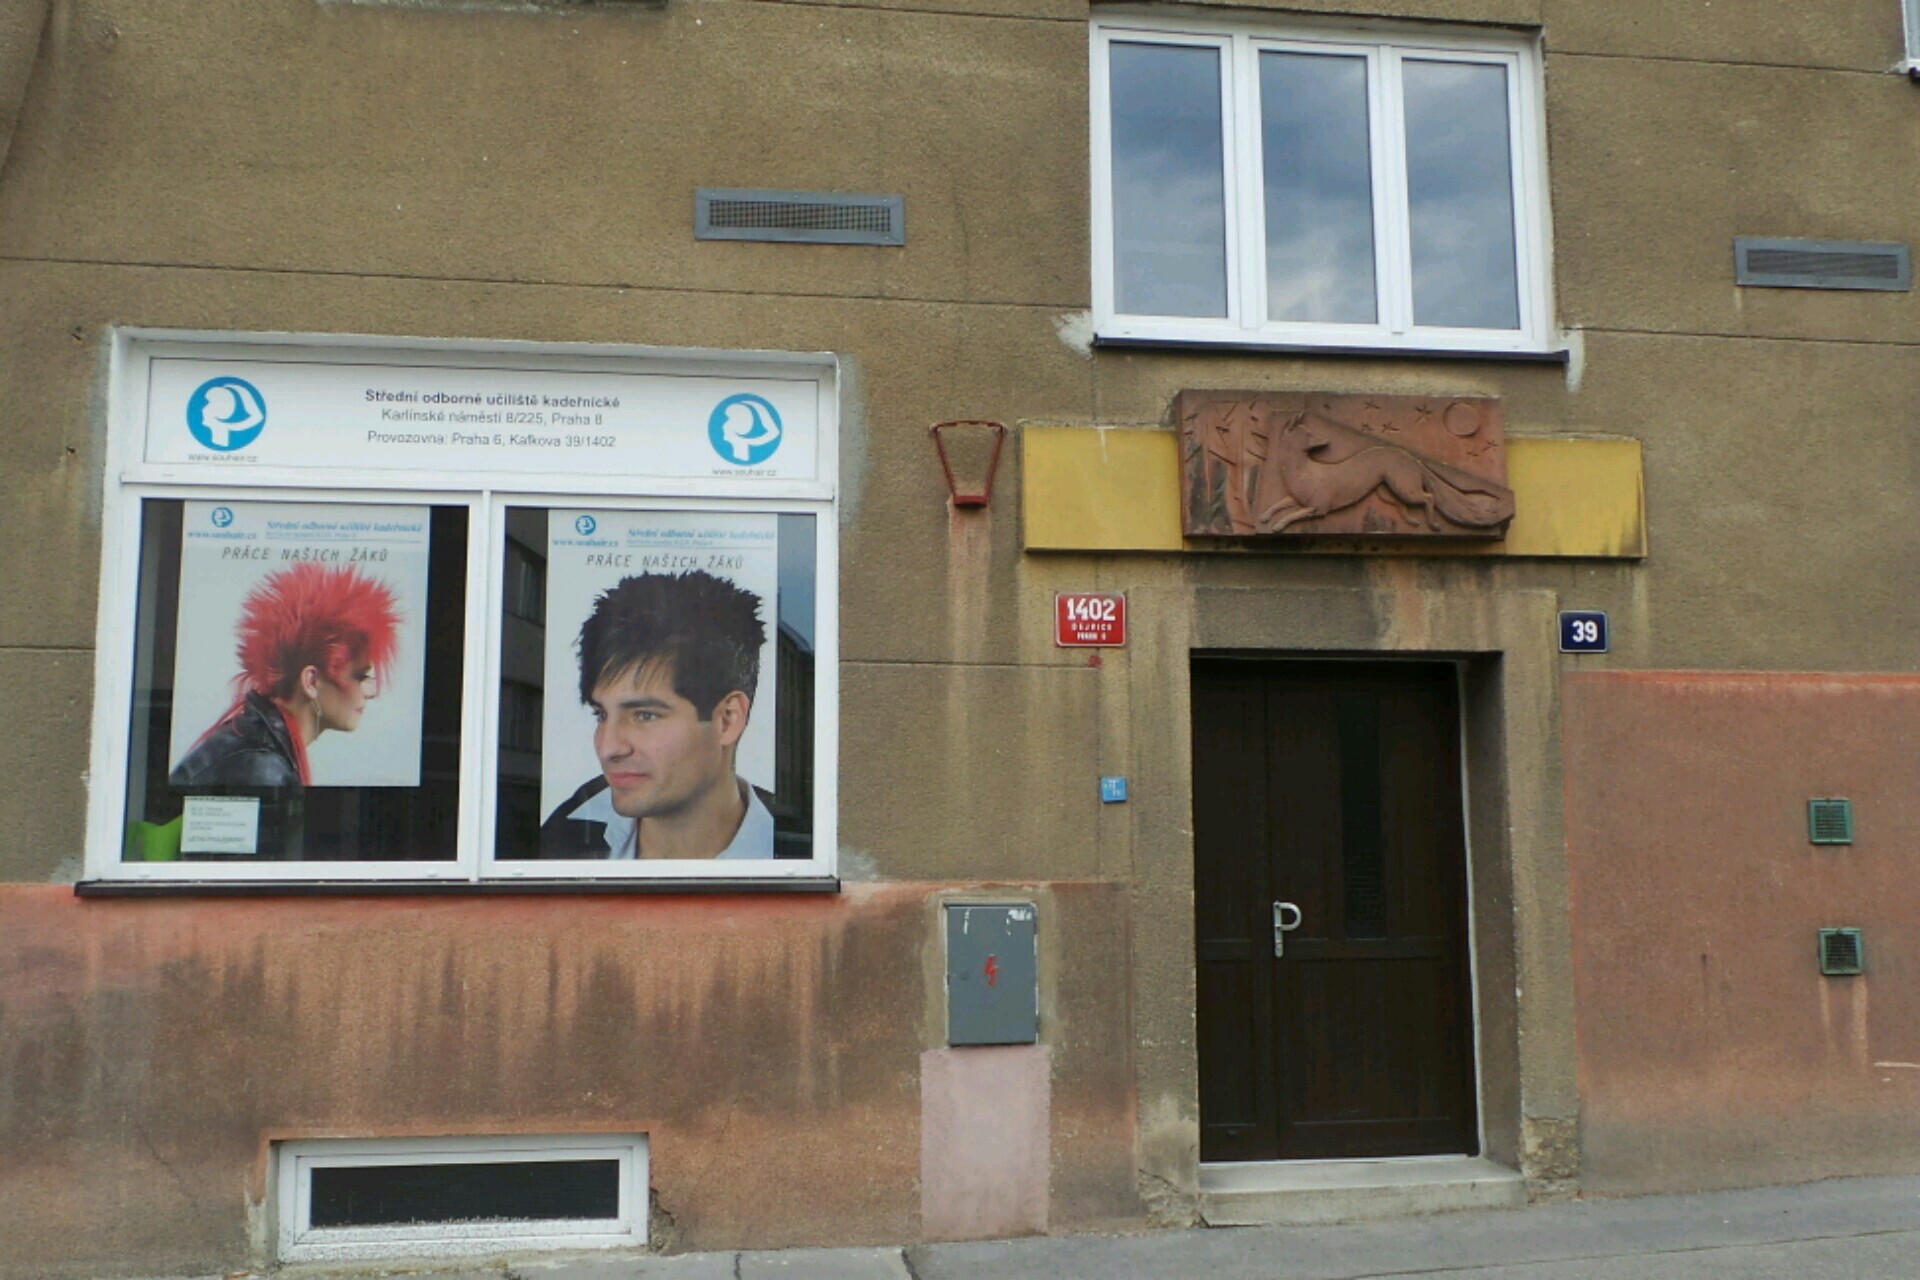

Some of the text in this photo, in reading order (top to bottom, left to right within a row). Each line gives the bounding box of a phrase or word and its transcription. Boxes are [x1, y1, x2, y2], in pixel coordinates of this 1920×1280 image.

[364, 389, 620, 408] Střední odborné učiliště kadeřnické
[381, 408, 444, 422] Karlínské
[449, 410, 501, 423] náměstí
[551, 412, 591, 426] Praha
[452, 432, 490, 445] Praha
[509, 434, 561, 447] Kafkova
[222, 545, 389, 562] PRÁCE NAŠICH ŽÁKŮ
[585, 553, 745, 570] PRÁCE NAŠICH ŽÁKŮ
[1067, 598, 1116, 621] 1402
[1572, 620, 1598, 643] 39
